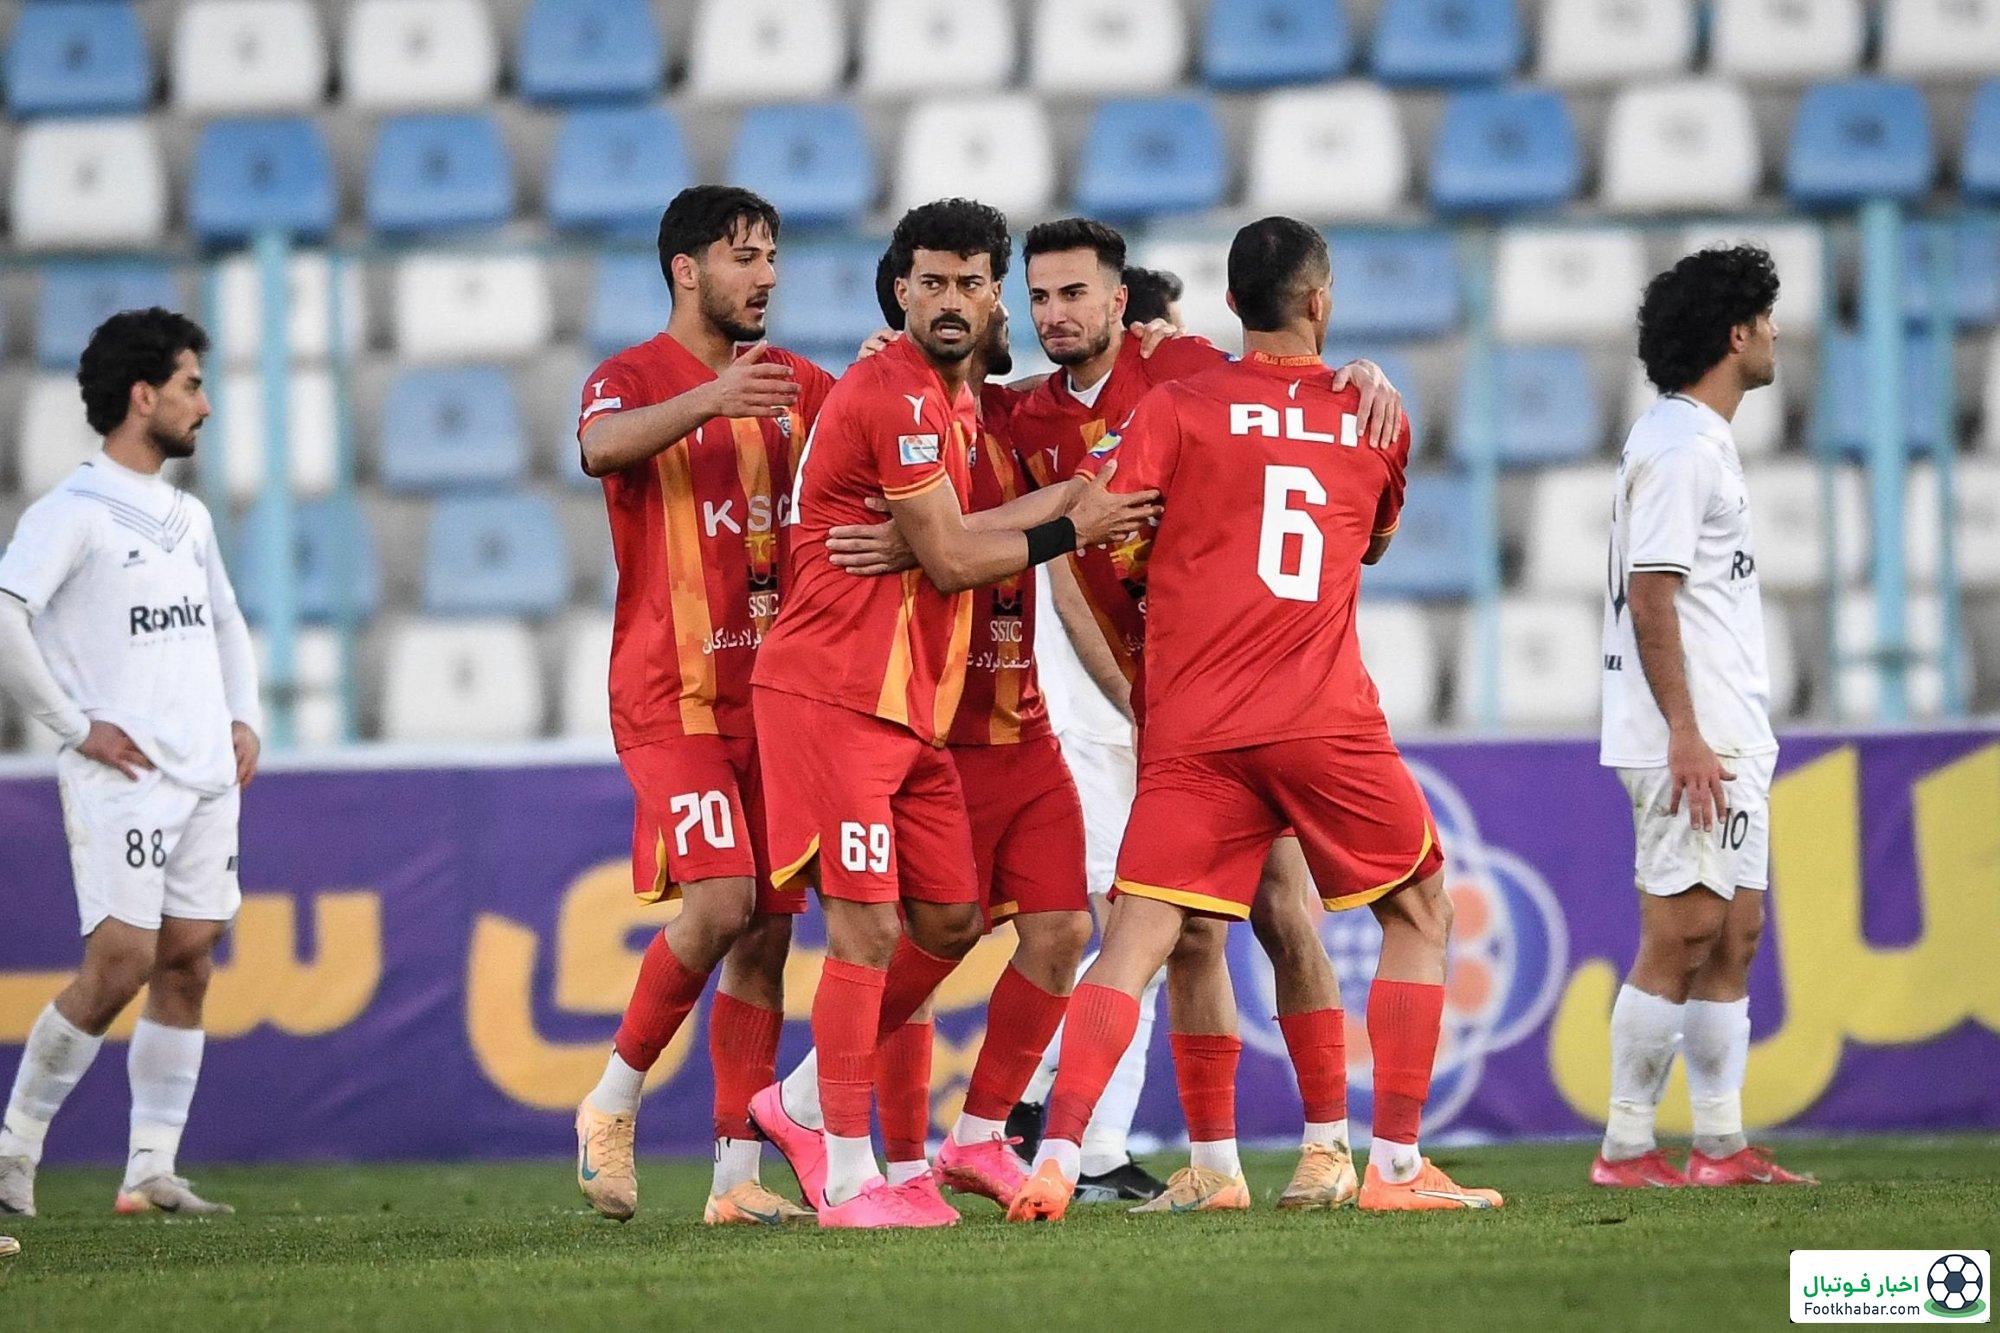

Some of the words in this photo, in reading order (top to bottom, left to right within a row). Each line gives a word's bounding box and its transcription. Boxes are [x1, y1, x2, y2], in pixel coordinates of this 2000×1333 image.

[1230, 403, 1358, 448] ALI
[703, 493, 790, 537] KSC
[1257, 464, 1327, 602] 6
[130, 595, 206, 636] Ronix
[748, 593, 779, 618] SSIC
[990, 620, 1022, 642] SSIC
[669, 790, 735, 856] 70
[1721, 807, 1748, 850] 10
[126, 828, 165, 868] 88
[840, 821, 890, 873] 69
